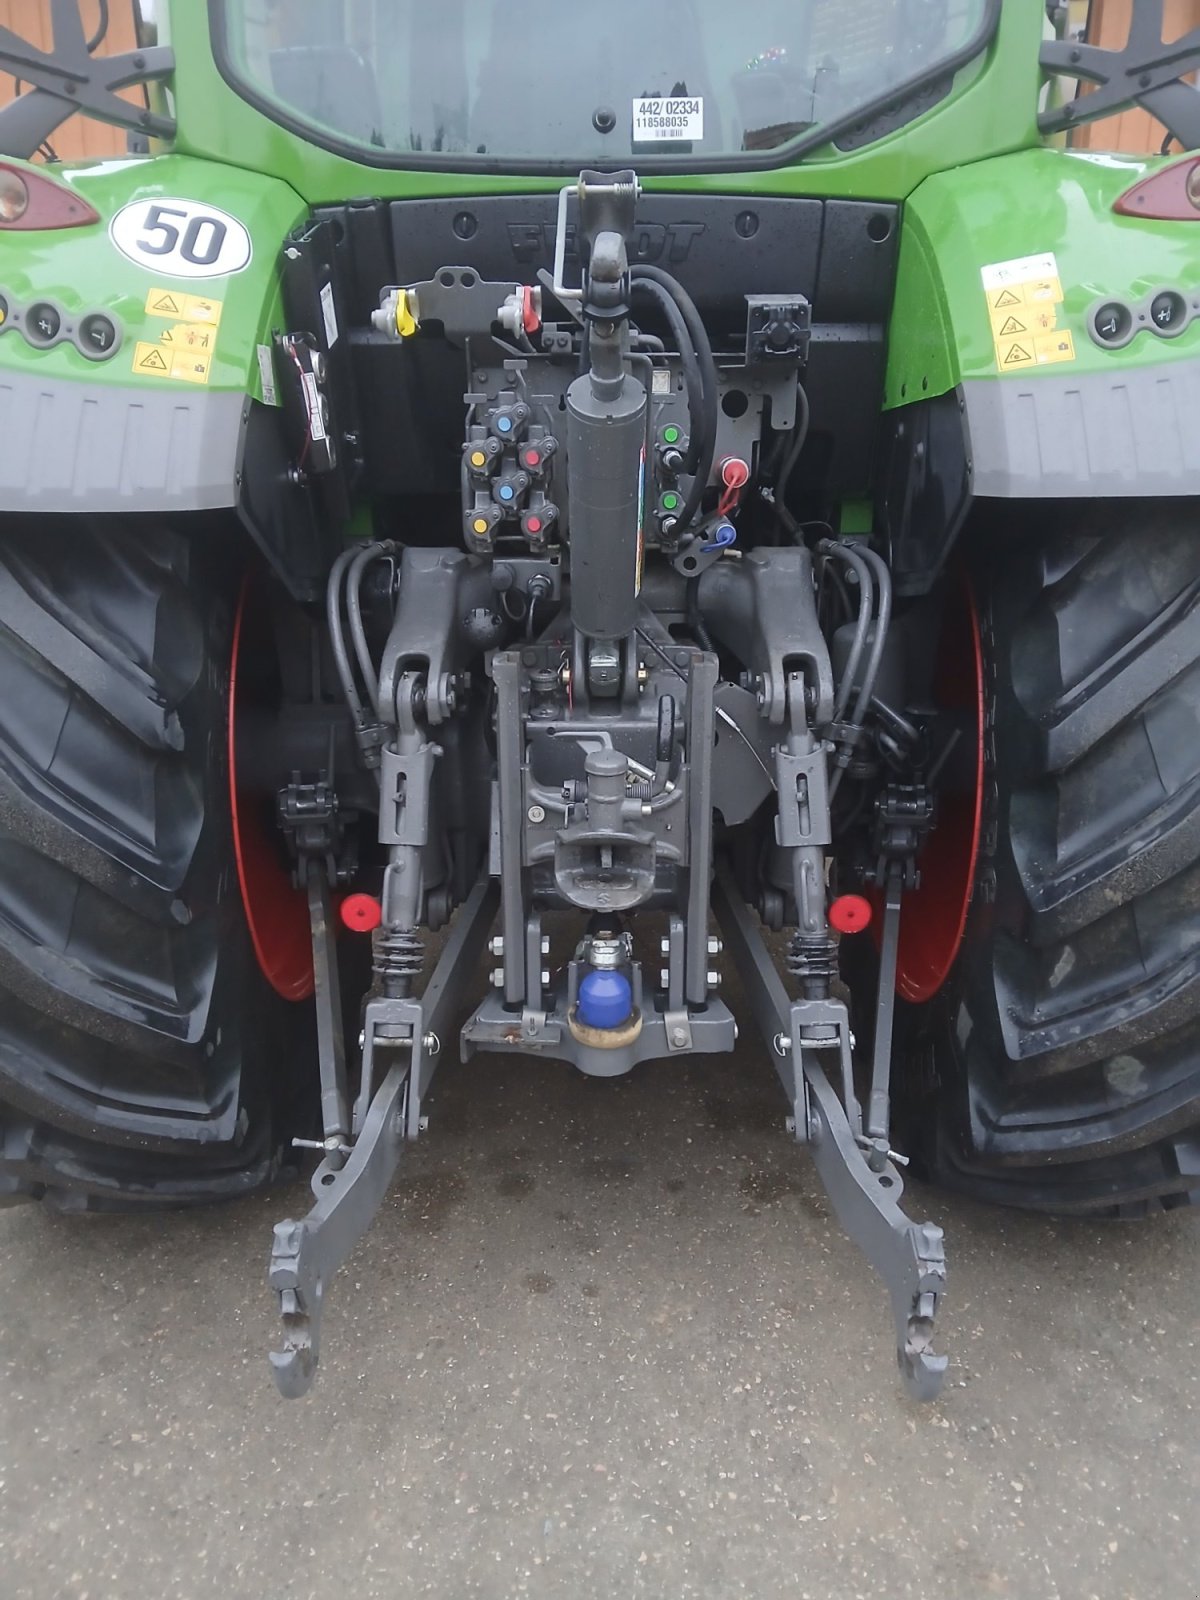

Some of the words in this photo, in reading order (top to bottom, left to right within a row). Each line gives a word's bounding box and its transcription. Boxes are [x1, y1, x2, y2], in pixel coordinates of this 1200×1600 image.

[636, 116, 689, 128] 118588035
[136, 205, 227, 265] 50
[506, 222, 705, 263] FEDT
